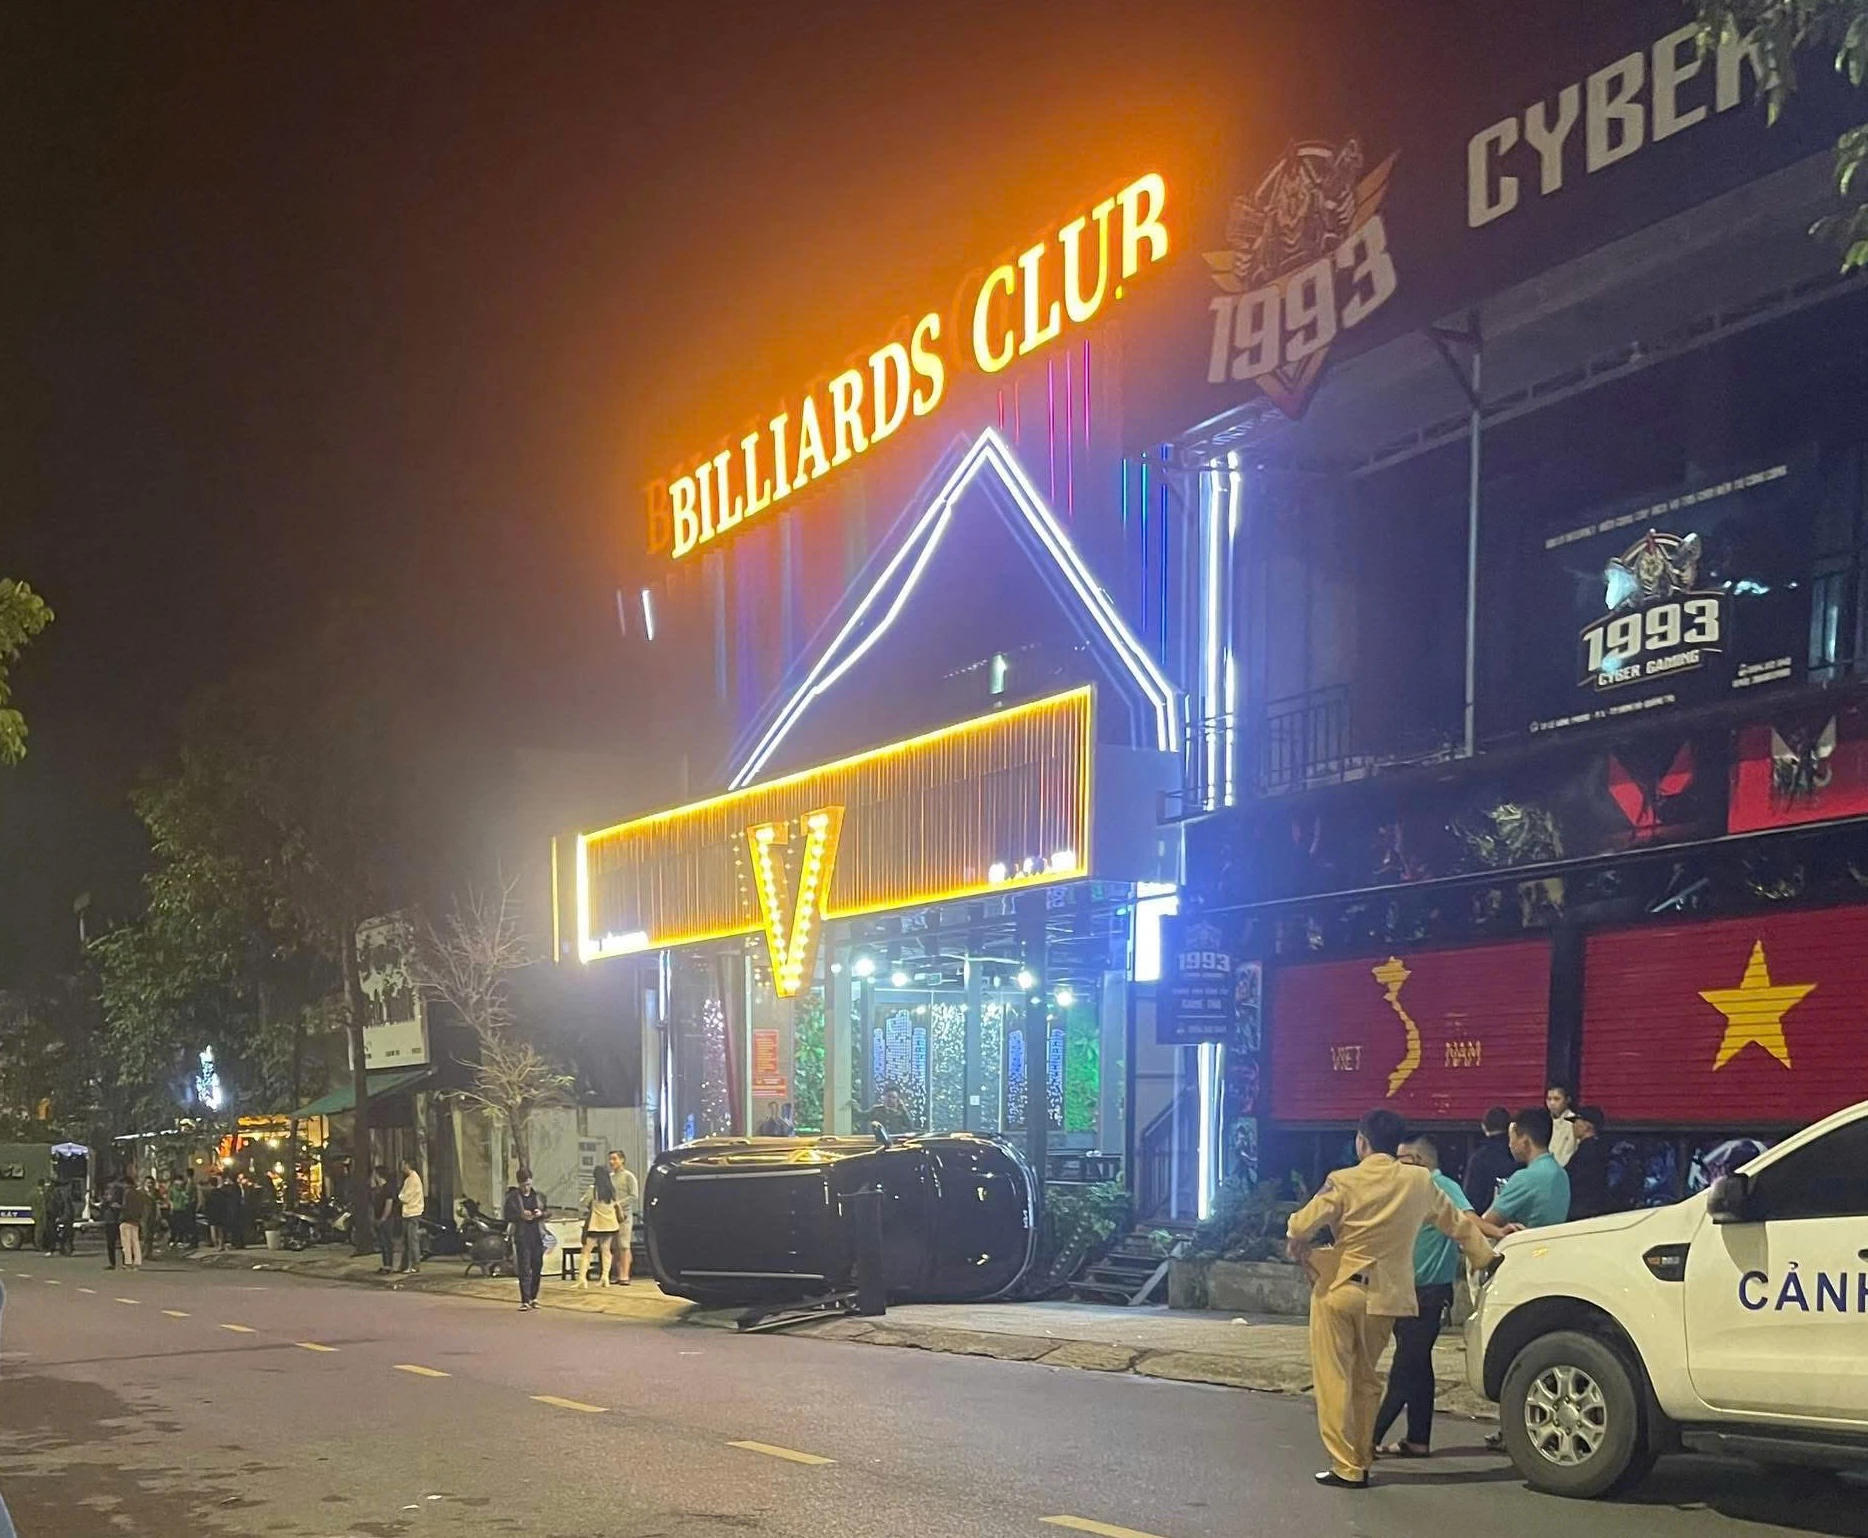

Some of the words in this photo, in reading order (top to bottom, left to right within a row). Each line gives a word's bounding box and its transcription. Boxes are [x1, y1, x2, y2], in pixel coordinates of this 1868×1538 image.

[1207, 214, 1398, 384] 1993
[670, 311, 945, 560] BILLIARDS
[1582, 598, 1720, 671] 1993
[747, 805, 844, 999] V
[1178, 952, 1231, 973] 1993
